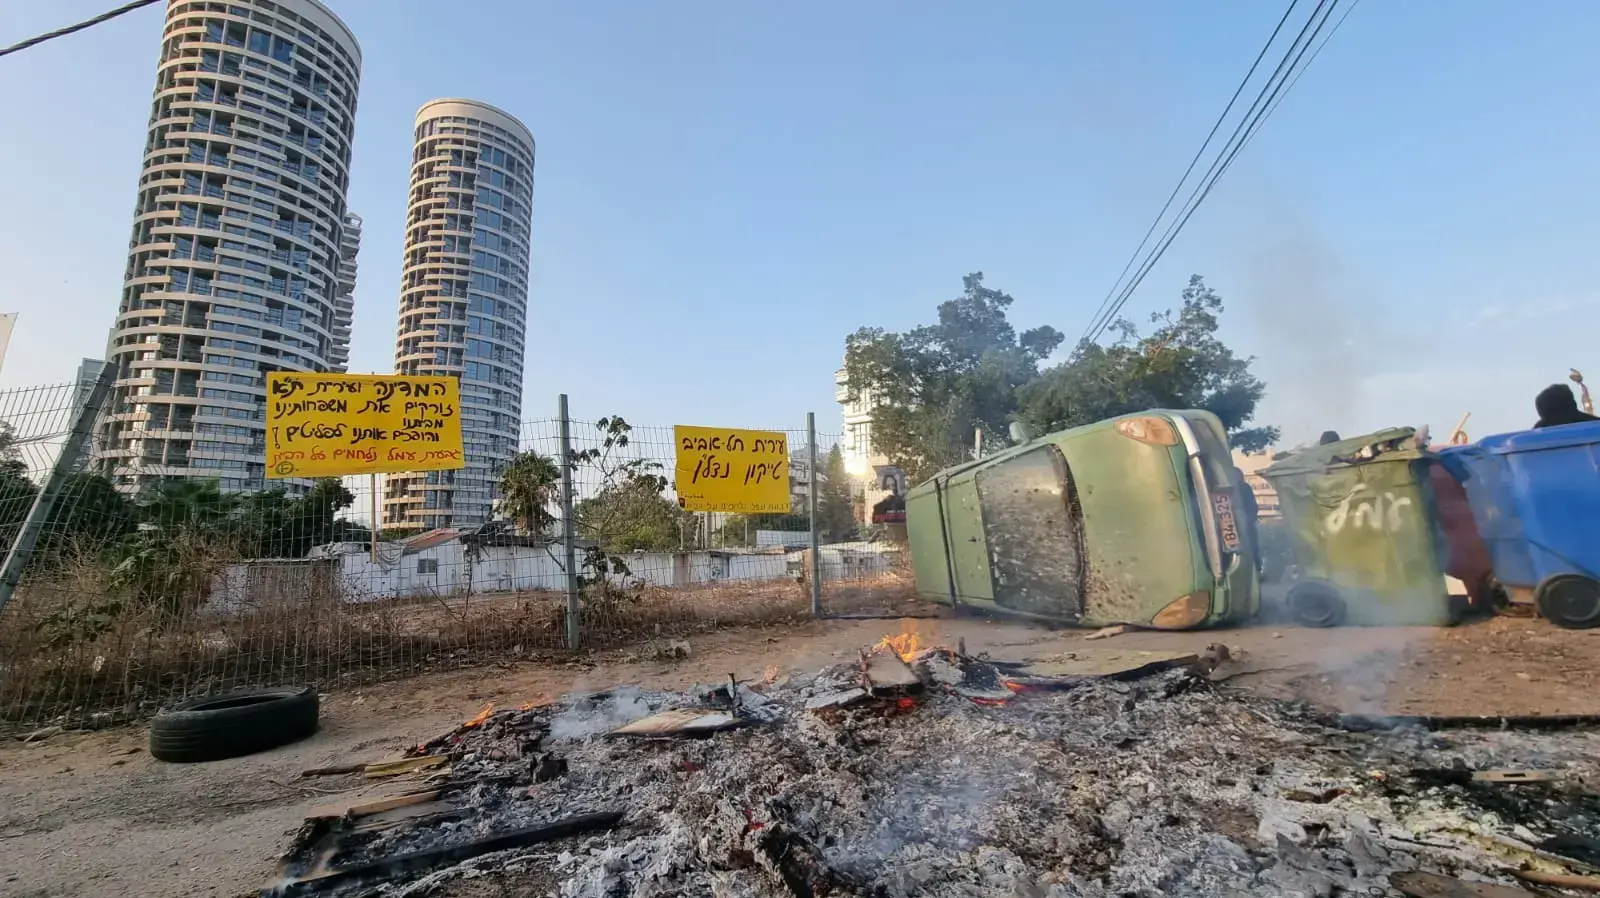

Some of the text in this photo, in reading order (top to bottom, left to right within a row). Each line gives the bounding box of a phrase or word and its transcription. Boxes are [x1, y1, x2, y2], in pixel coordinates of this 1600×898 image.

[375, 381, 447, 401] המדינה
[273, 399, 455, 420] זורקים את משפחותינו
[350, 427, 388, 445] אותנו
[392, 430, 440, 442] והופכים
[682, 434, 744, 452] תל-אביב
[268, 445, 461, 468] גבעת עמל נלחמים על הבית
[743, 460, 783, 486] טייקון
